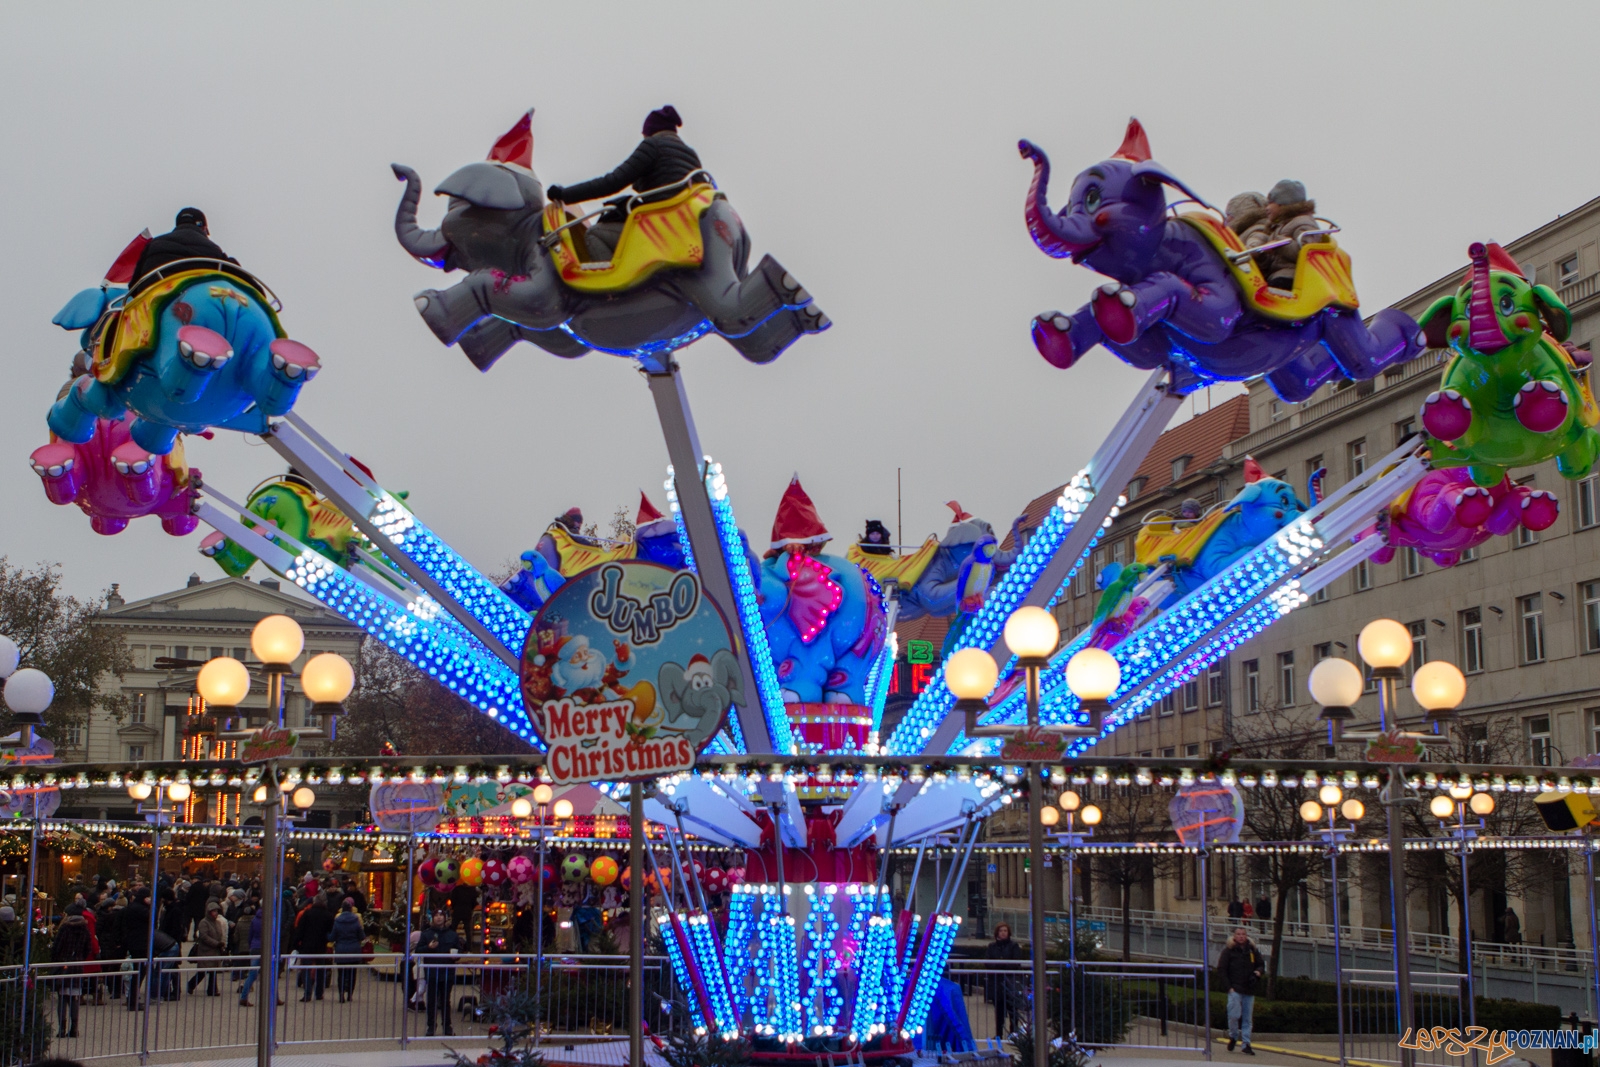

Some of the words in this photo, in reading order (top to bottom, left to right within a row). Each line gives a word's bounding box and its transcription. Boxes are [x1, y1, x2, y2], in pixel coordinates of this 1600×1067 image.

[591, 565, 699, 645] JUMBO
[547, 703, 630, 740] Merry
[551, 739, 690, 779] Christmas
